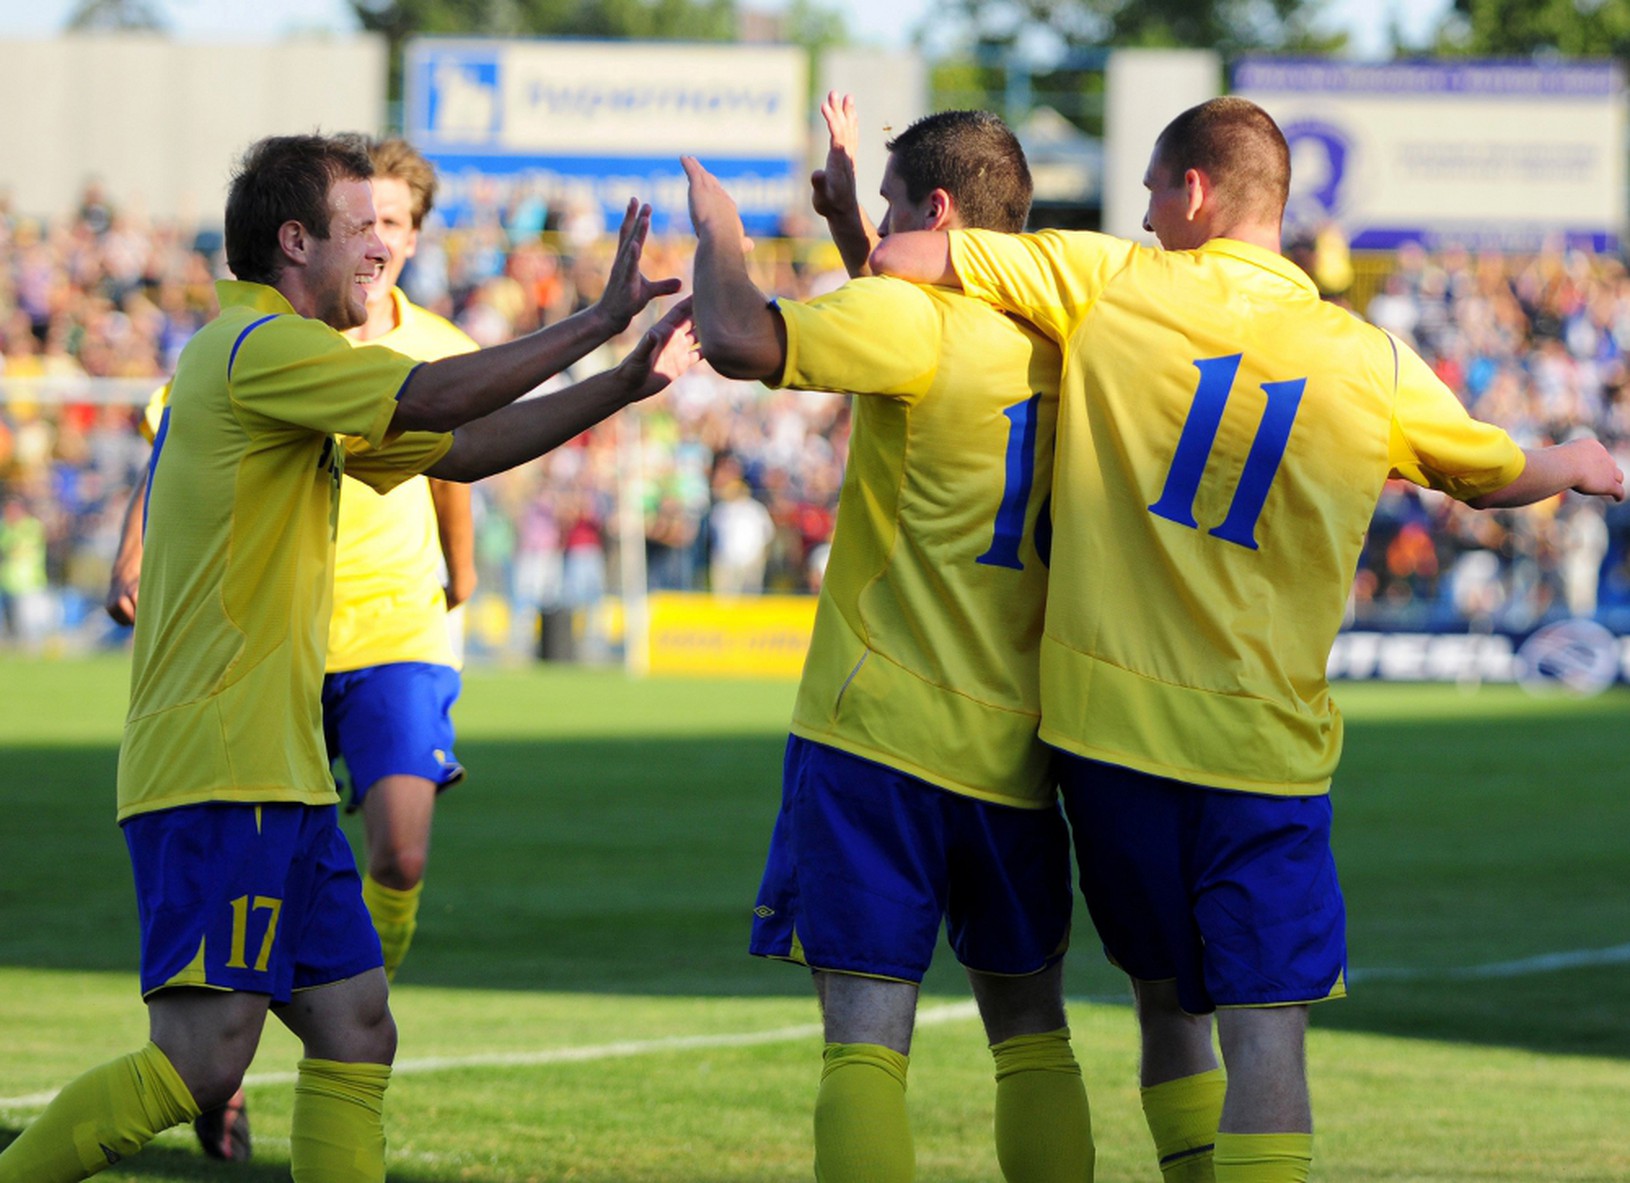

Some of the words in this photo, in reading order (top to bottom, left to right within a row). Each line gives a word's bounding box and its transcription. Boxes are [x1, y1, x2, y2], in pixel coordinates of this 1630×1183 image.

[975, 391, 1052, 571] 1
[1147, 352, 1307, 550] 11
[225, 894, 283, 972] 17
